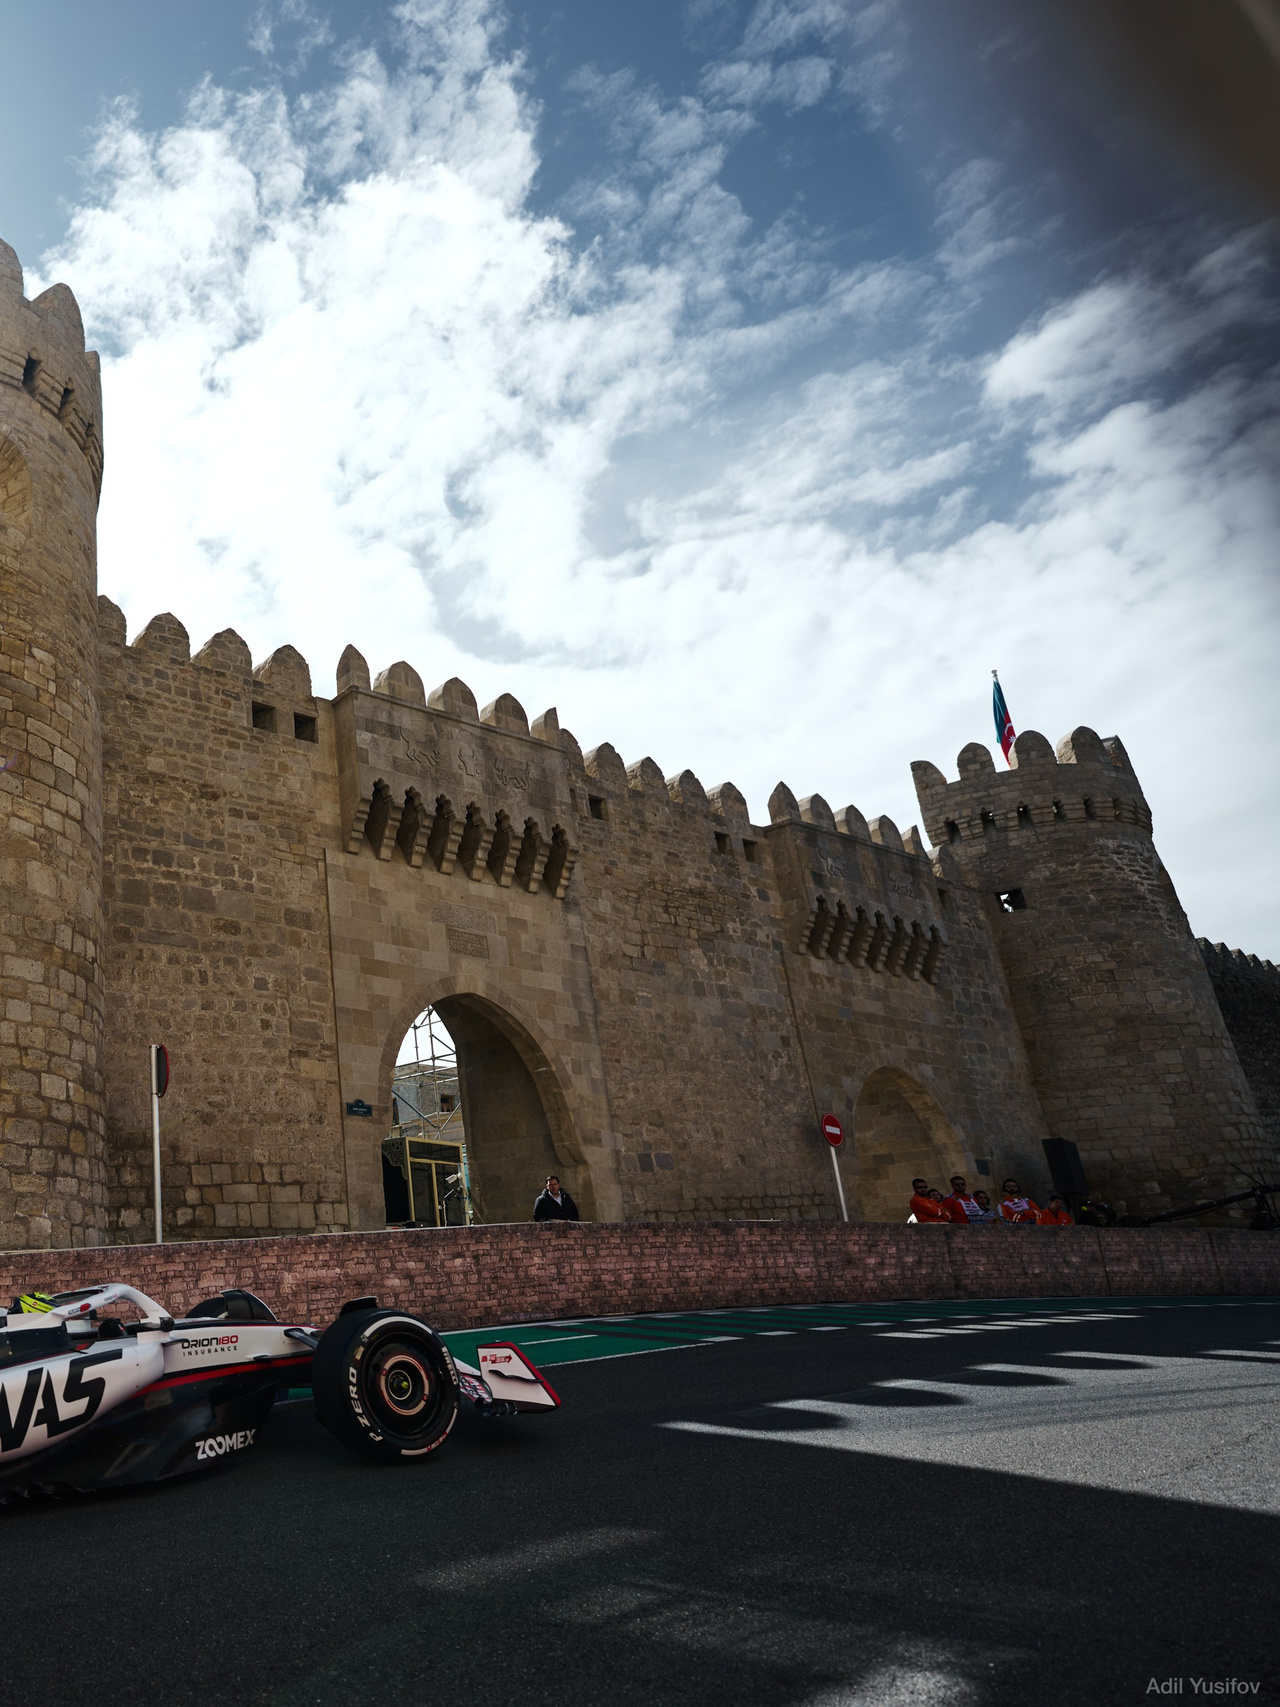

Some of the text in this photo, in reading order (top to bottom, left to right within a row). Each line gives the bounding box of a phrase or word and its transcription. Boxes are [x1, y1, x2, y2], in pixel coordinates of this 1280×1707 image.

[183, 1345, 238, 1356] INSURANCE
[349, 1366, 371, 1427] ZERO
[195, 1428, 256, 1460] ZOOMEX
